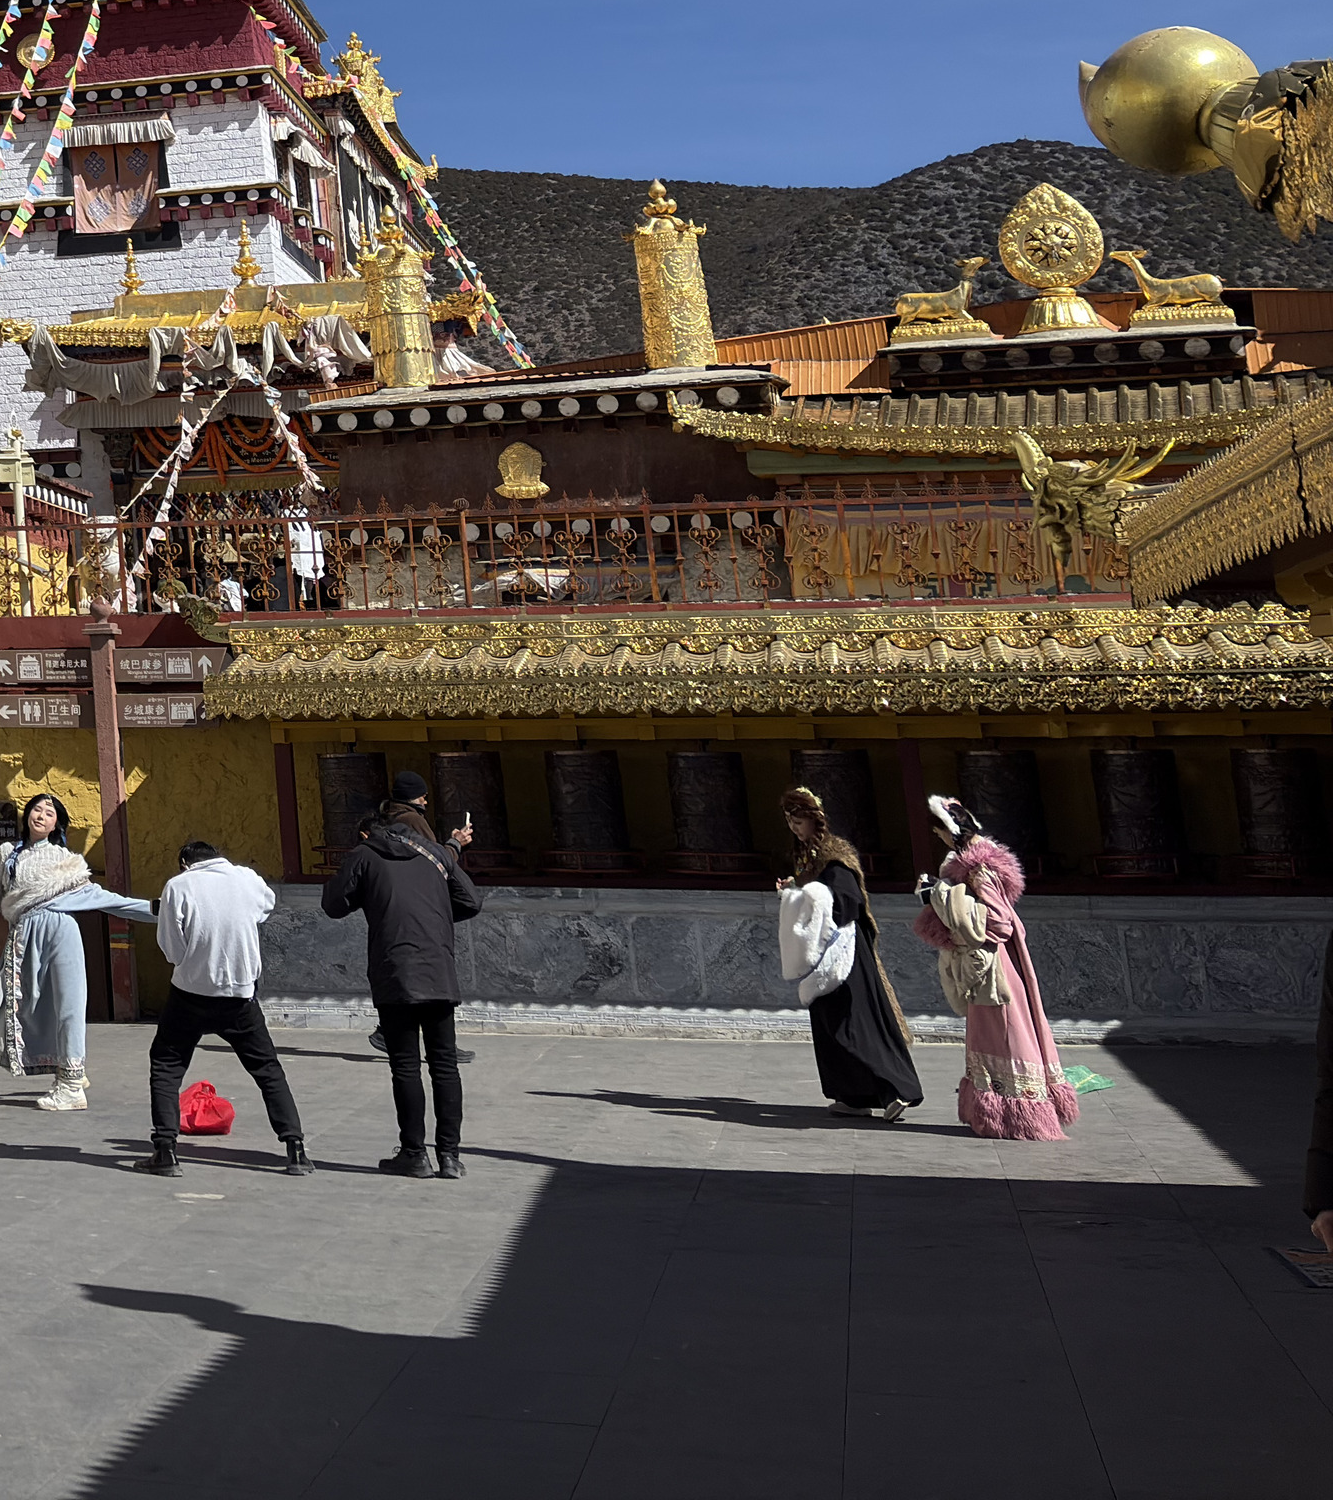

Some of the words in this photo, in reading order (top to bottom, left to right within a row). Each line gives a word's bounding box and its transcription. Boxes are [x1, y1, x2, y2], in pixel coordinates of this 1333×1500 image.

[120, 659, 162, 670] 绒巴康参
[49, 704, 81, 716] 卫生间
[124, 704, 165, 716] 乡城康参
